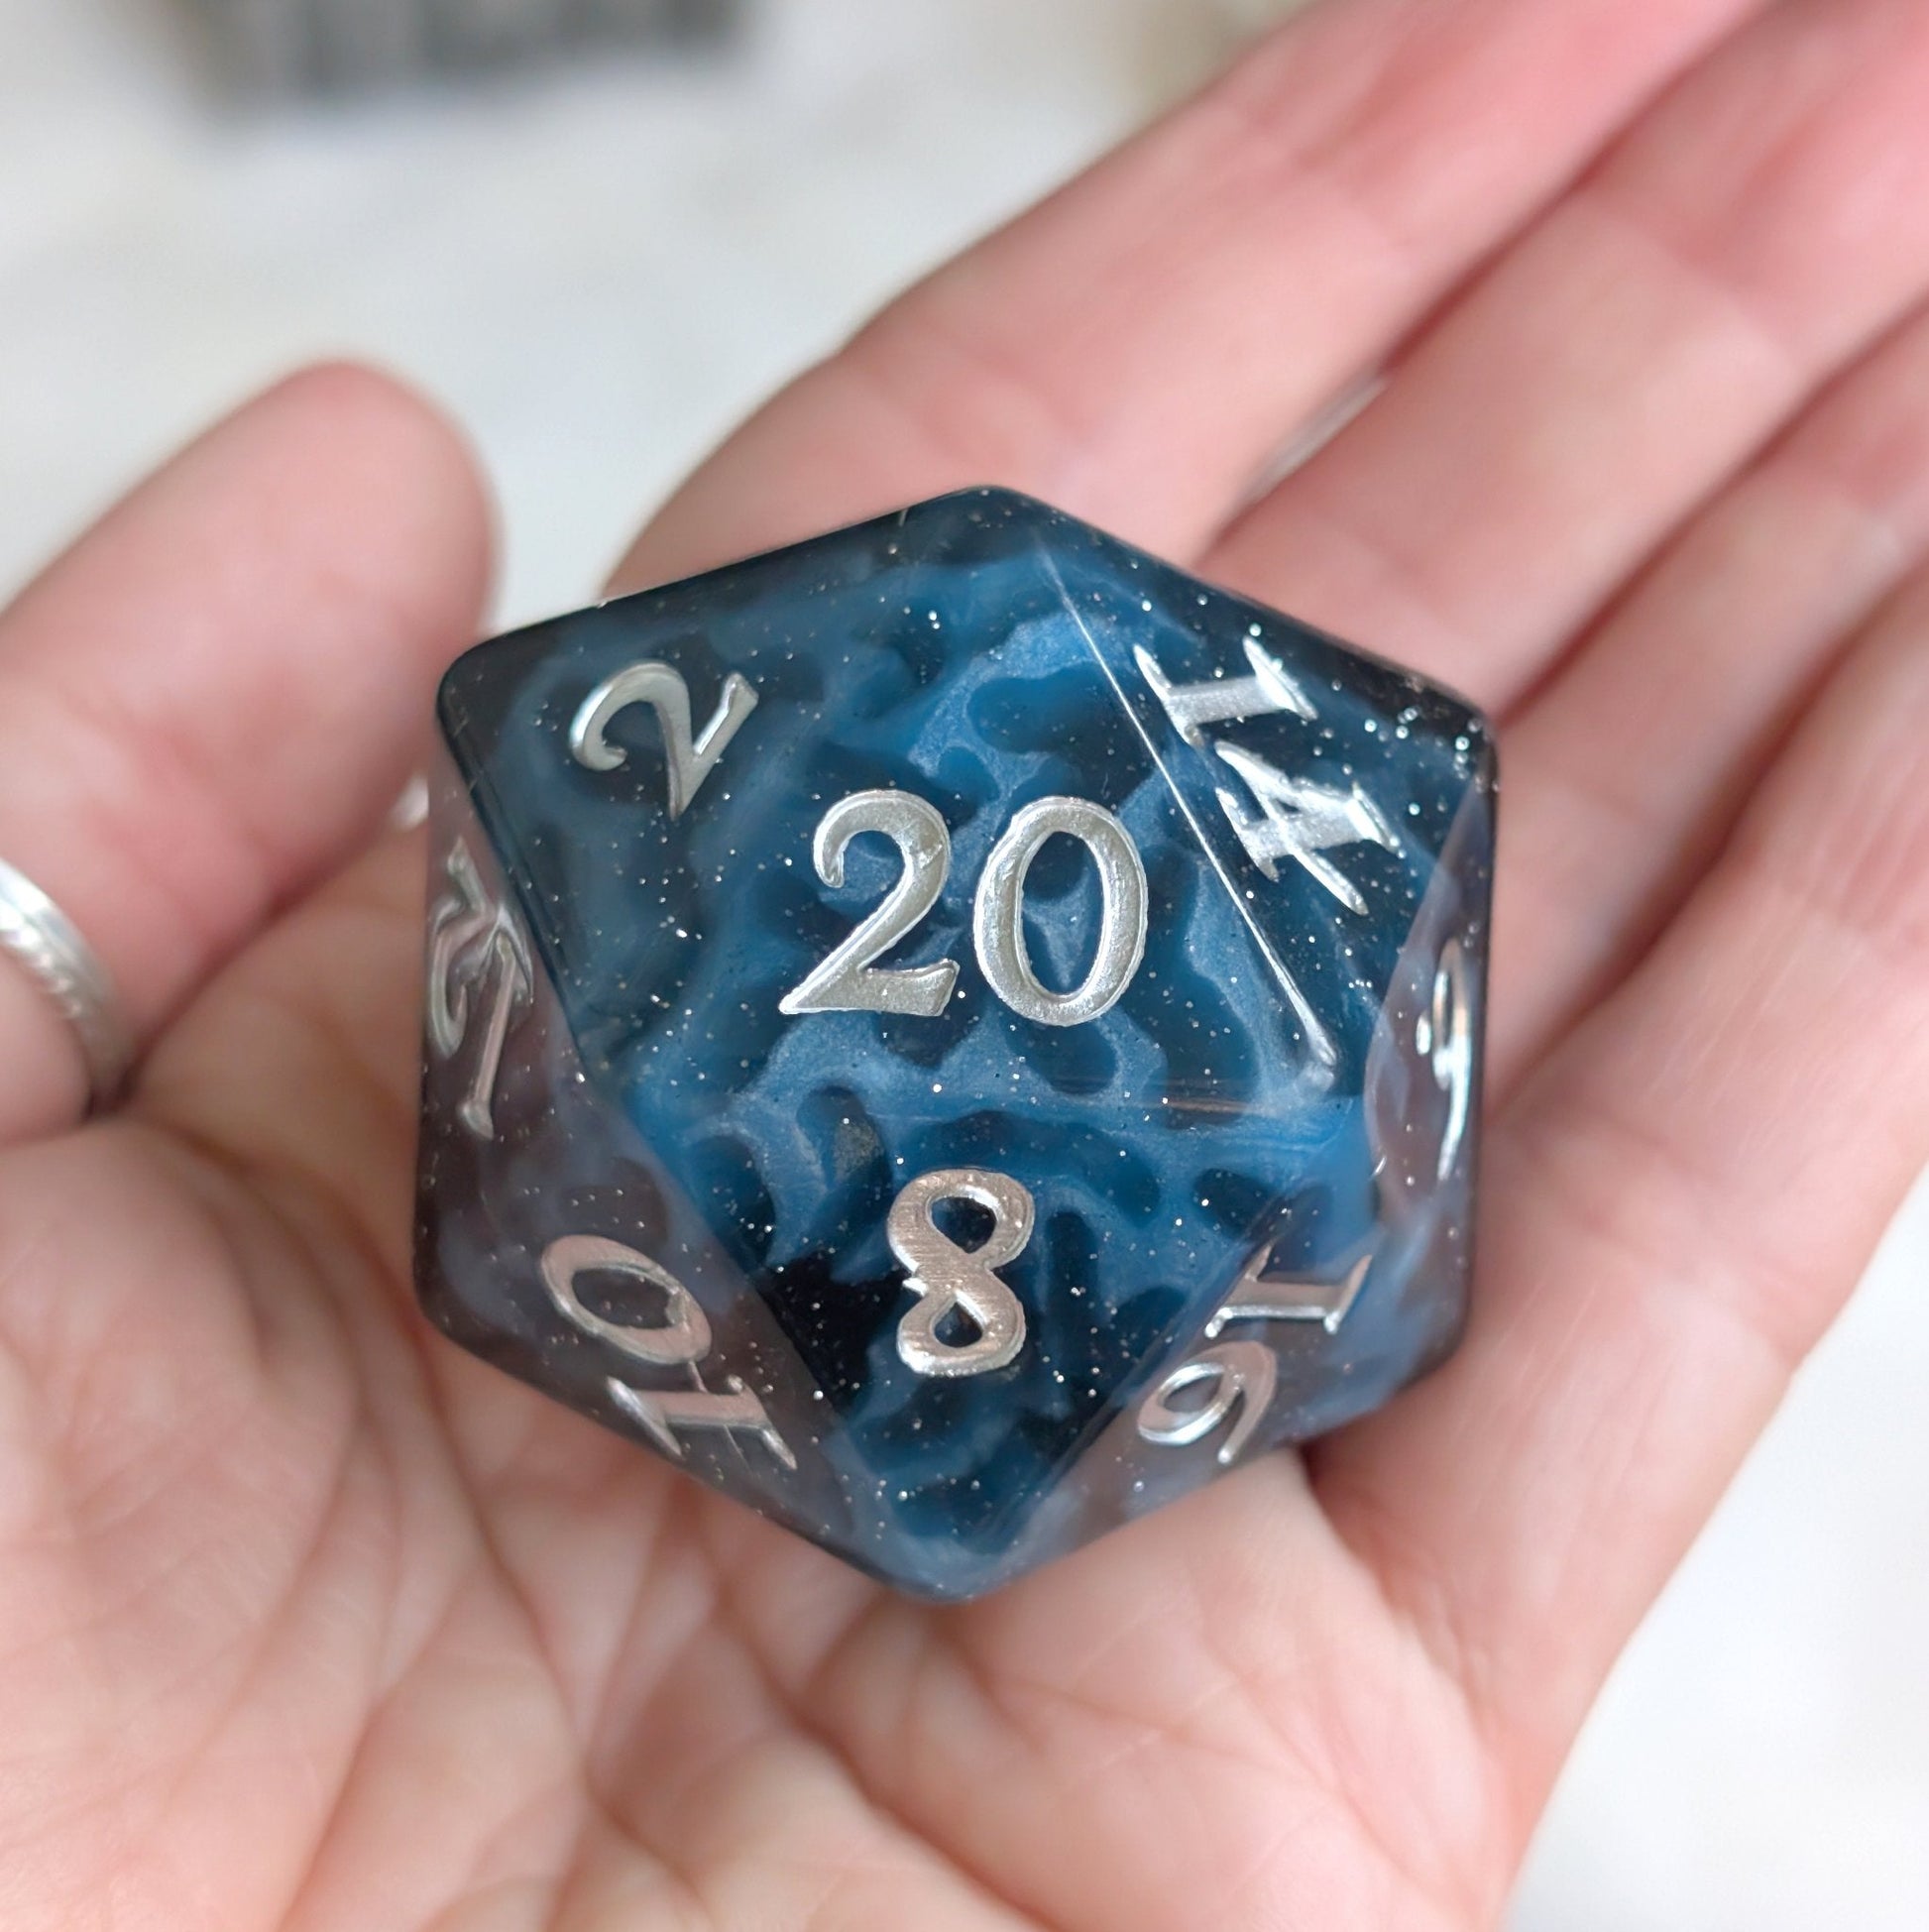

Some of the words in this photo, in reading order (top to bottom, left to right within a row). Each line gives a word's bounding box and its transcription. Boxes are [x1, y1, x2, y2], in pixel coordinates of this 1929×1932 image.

[568, 661, 759, 821] 2
[1133, 636, 1405, 915] 14
[779, 789, 1148, 1027] 20
[538, 1234, 796, 1469] 10
[886, 1168, 1035, 1377] 8
[1137, 1242, 1371, 1464] 16
